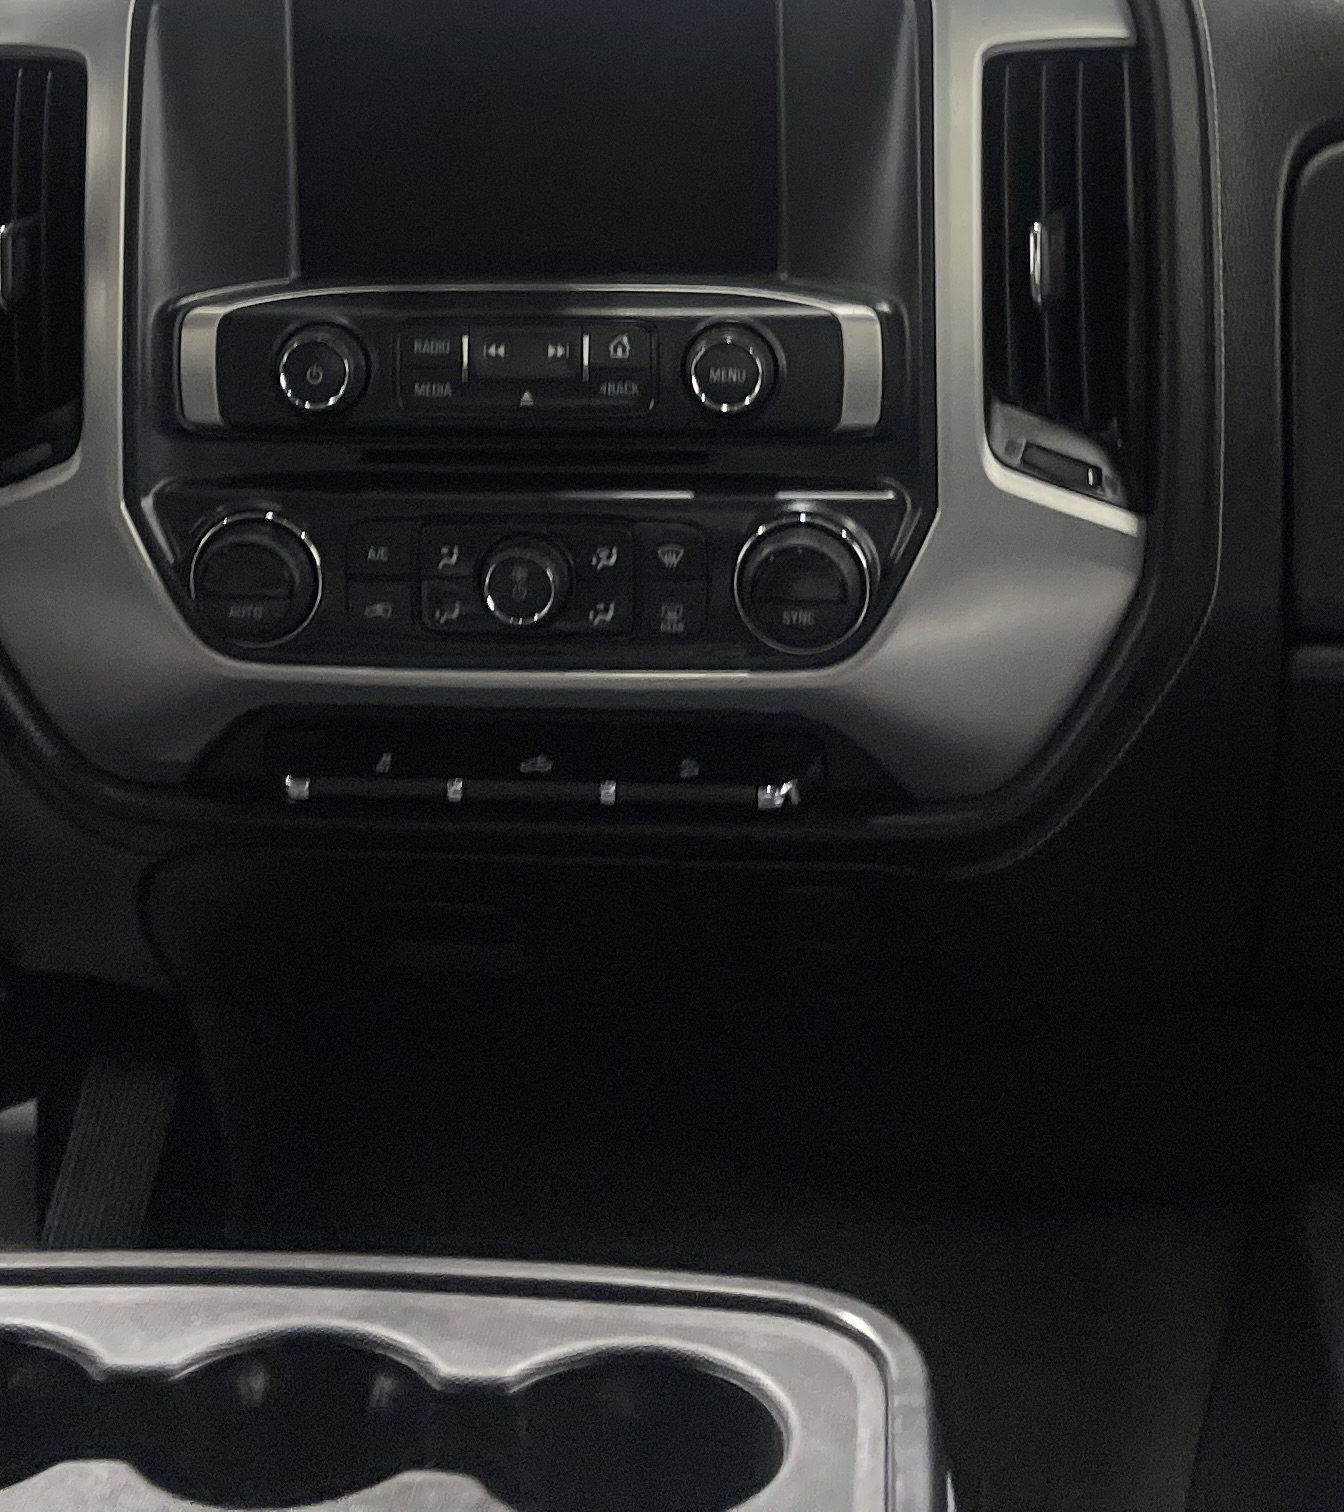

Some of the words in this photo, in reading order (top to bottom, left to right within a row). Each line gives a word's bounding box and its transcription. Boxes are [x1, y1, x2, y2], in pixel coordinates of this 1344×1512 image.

[412, 339, 451, 355] RADIO
[708, 366, 747, 384] MENU
[413, 382, 453, 398] MEDIA
[605, 381, 640, 397] BACK
